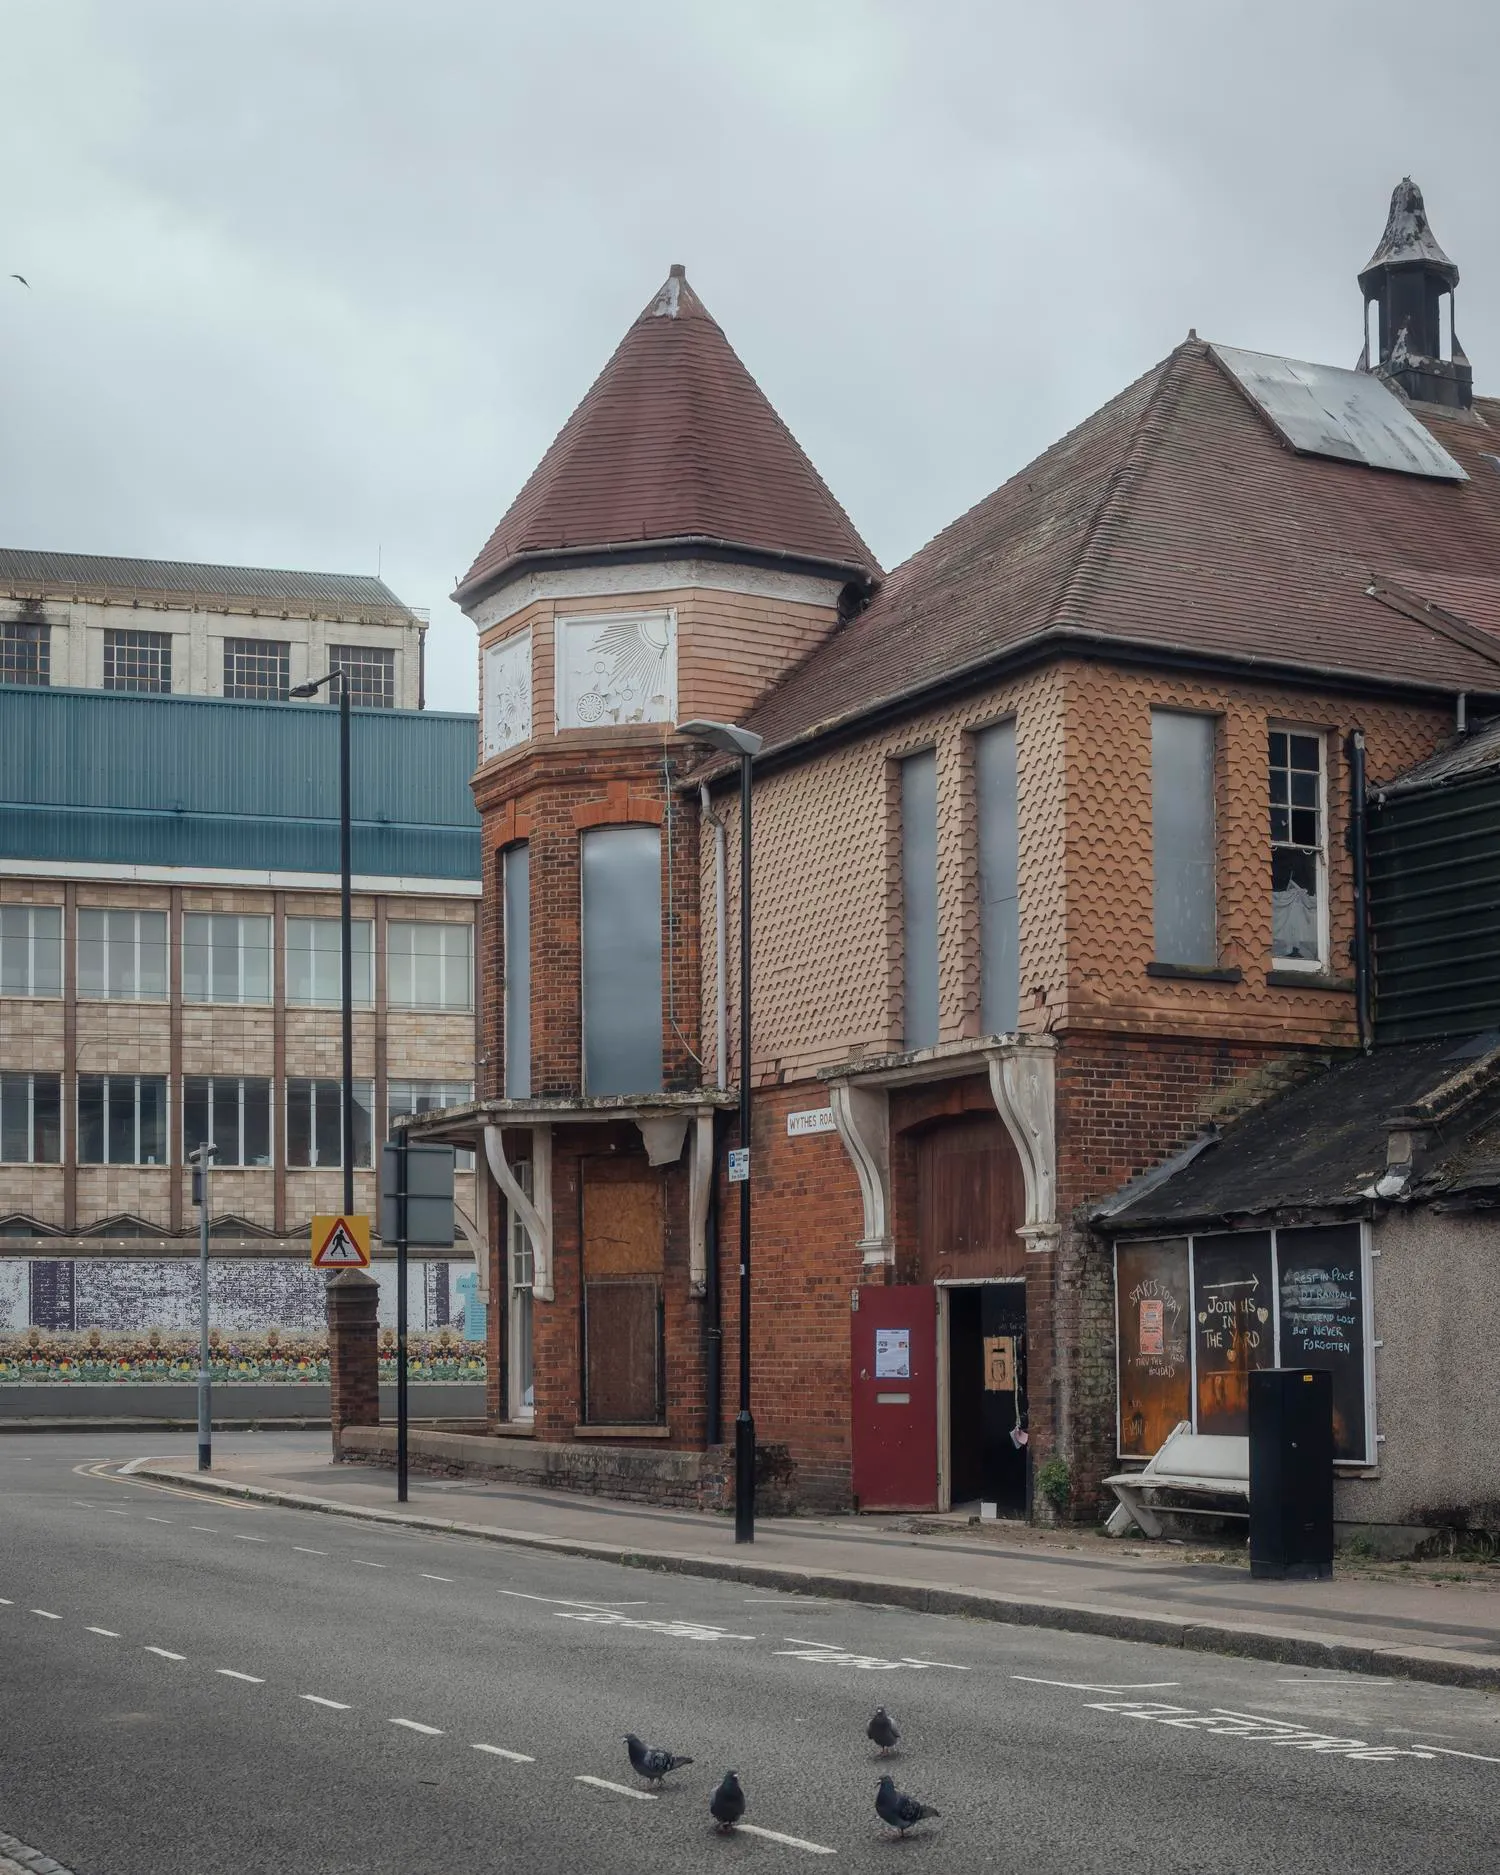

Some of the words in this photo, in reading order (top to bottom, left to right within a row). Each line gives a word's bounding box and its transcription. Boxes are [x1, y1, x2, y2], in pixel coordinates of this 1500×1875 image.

[790, 1114, 817, 1130] WYTHES
[819, 1111, 833, 1126] ROA
[1294, 1271, 1319, 1284] REST
[1317, 1288, 1356, 1300] RANDALL
[1129, 1278, 1159, 1307] STARTS
[1159, 1285, 1182, 1328] TODAY
[1207, 1295, 1237, 1313] JOIN
[1240, 1297, 1257, 1313] US
[1222, 1315, 1237, 1329] IN
[1337, 1315, 1357, 1324] LOST
[1201, 1329, 1223, 1349] THE
[1228, 1329, 1260, 1349] YRD
[1313, 1325, 1344, 1337] NEVER
[1303, 1338, 1351, 1354] FORGOTTEN
[1083, 1702, 1437, 1761] ELECTRIC
